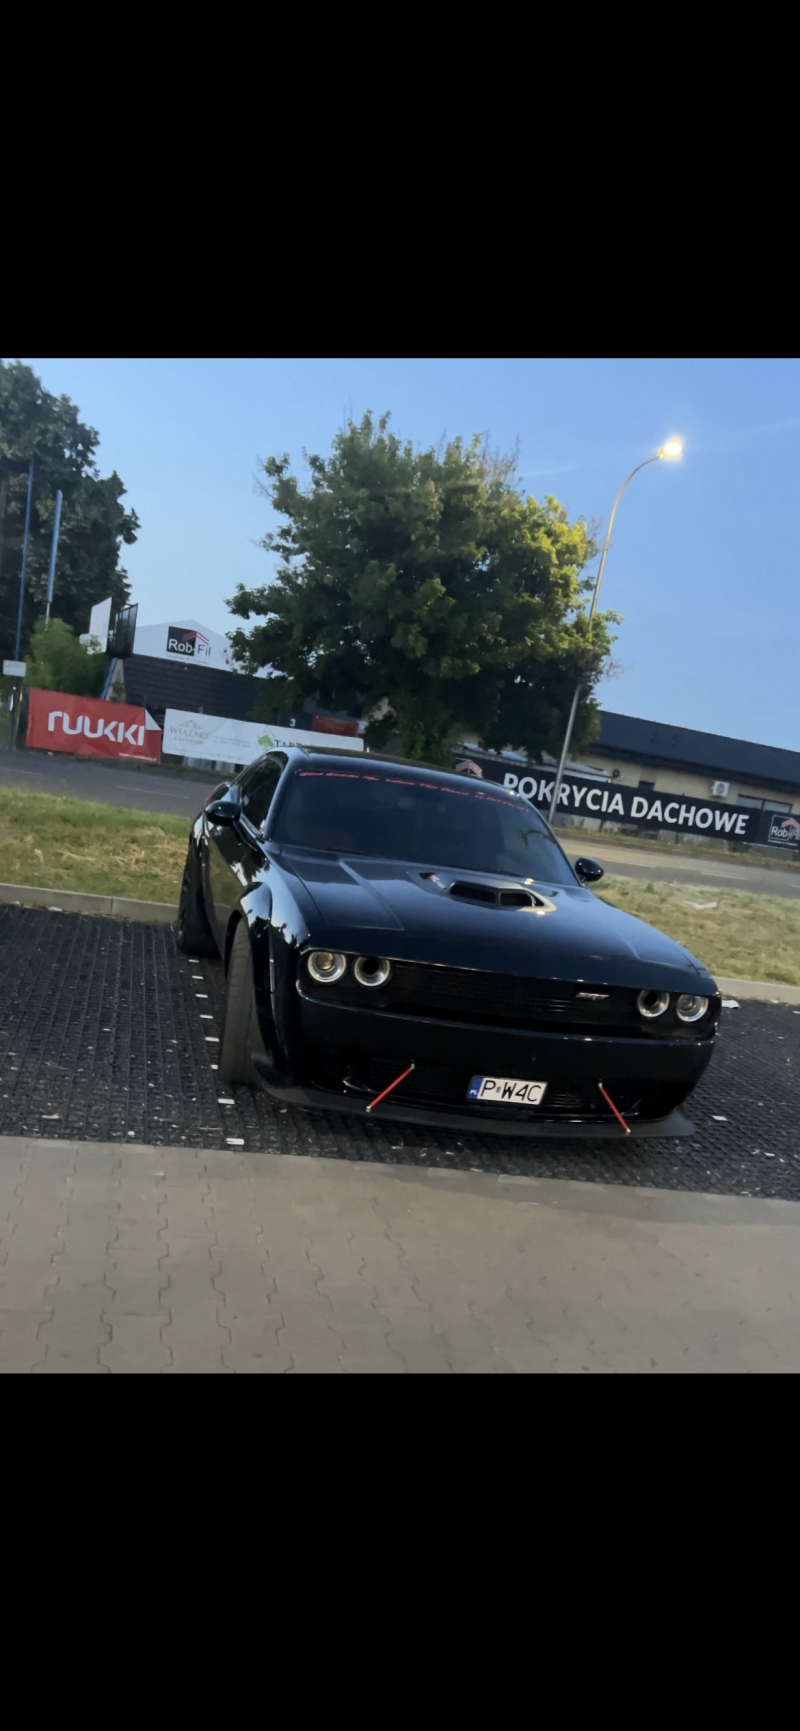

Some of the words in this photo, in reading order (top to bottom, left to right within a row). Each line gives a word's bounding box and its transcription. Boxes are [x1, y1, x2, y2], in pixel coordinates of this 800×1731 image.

[168, 638, 211, 657] Rob-Fil
[48, 710, 145, 746] ruukki
[289, 718, 296, 727] 3
[503, 772, 625, 816] POKRYCIA
[630, 796, 749, 835] DACHOWE
